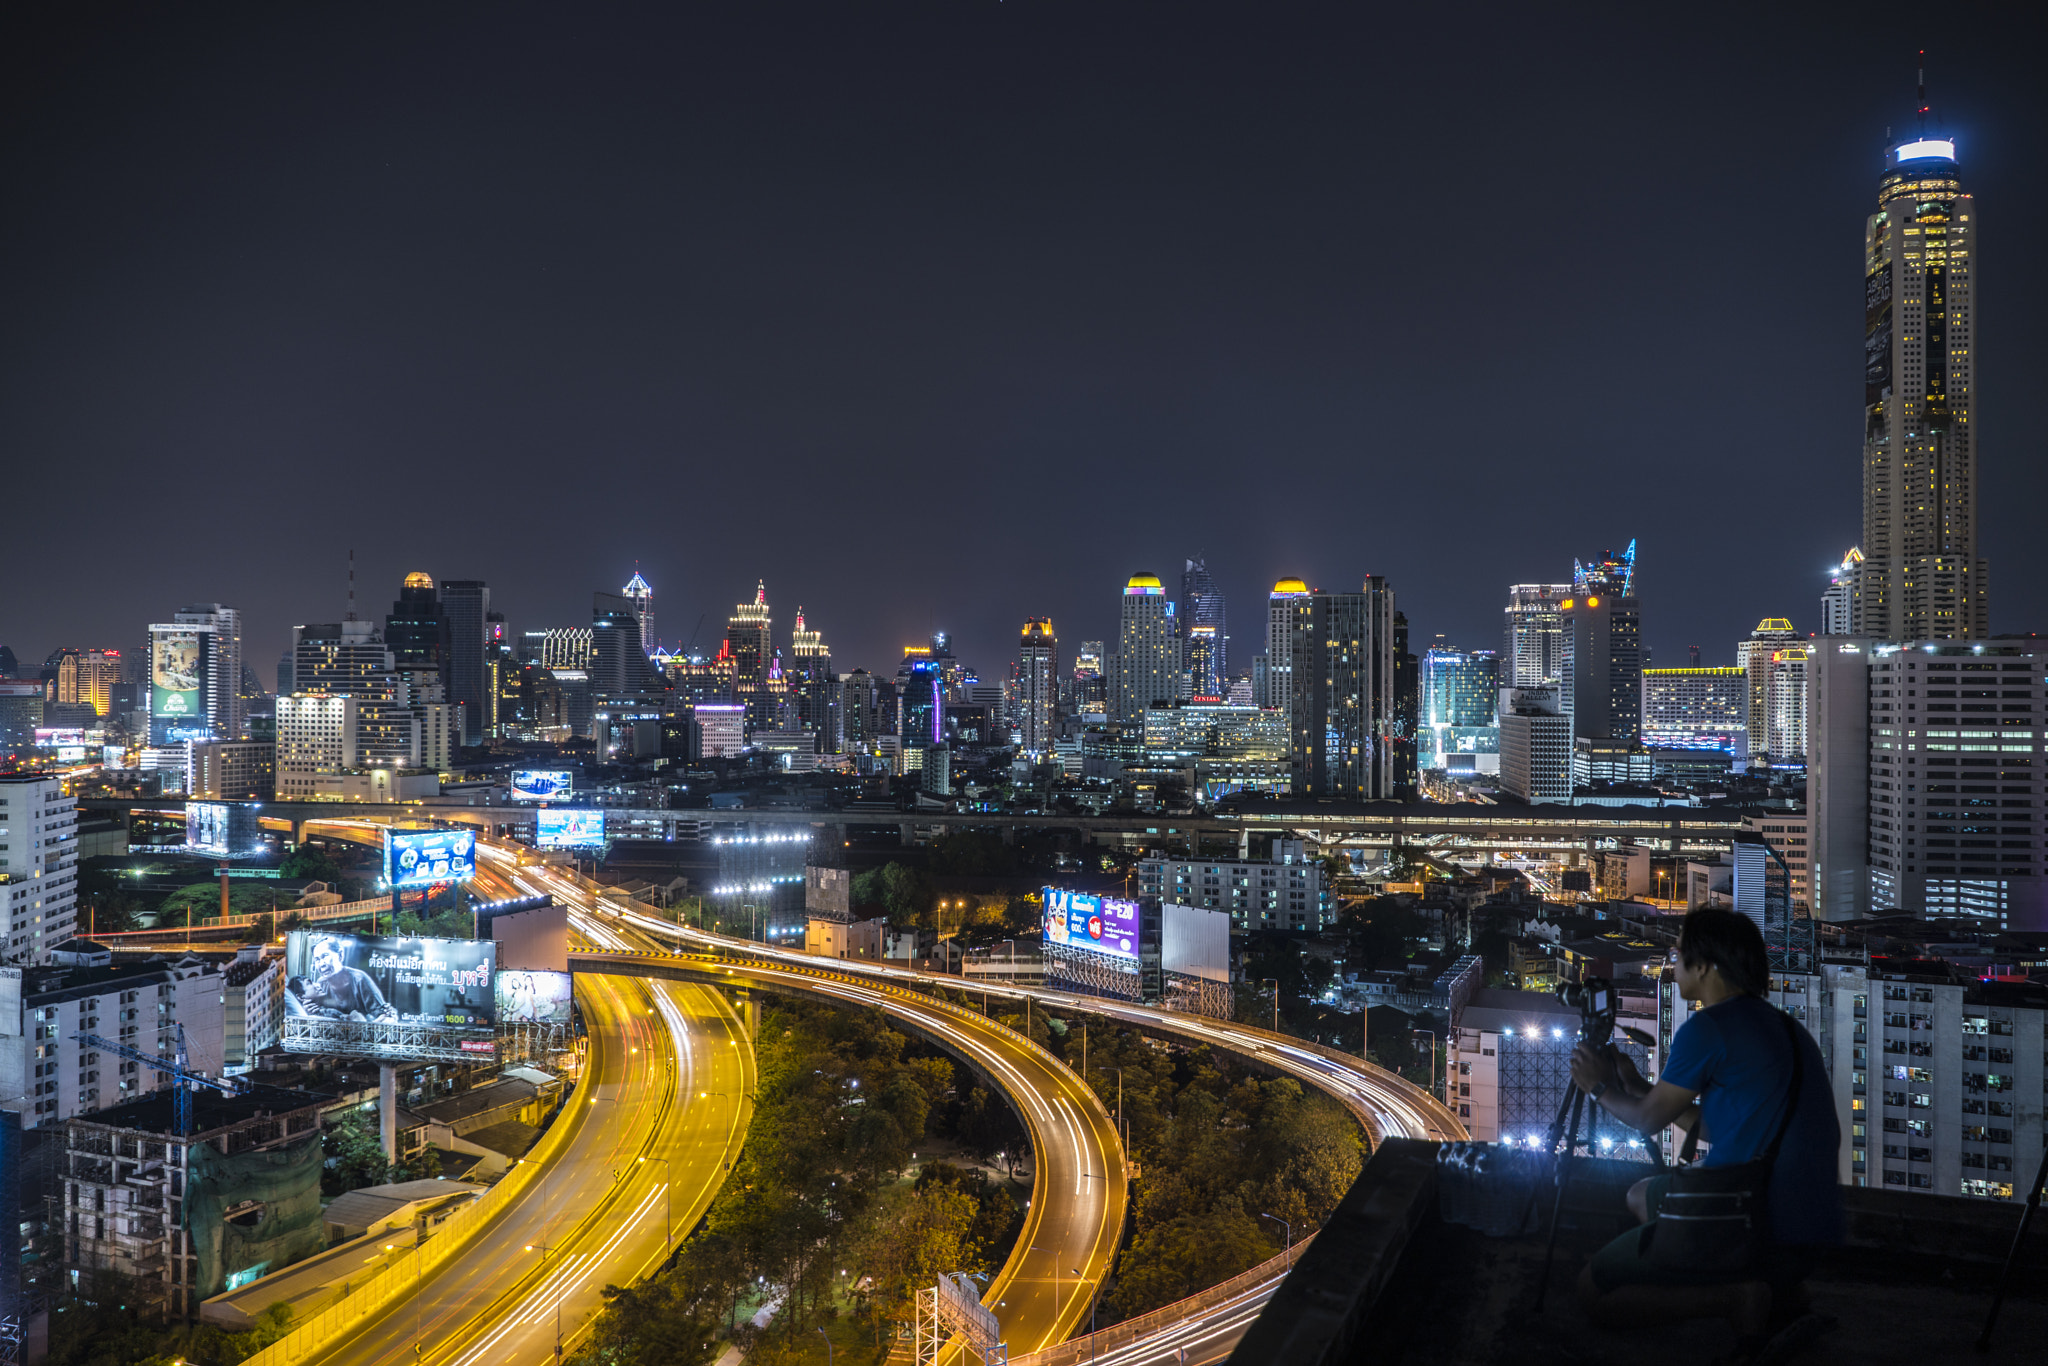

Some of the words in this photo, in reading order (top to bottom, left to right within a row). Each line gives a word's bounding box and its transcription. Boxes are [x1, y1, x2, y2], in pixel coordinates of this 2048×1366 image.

[163, 704, 188, 713] Chang
[452, 957, 490, 995] บุหรี่
[445, 1014, 465, 1024] 1600
